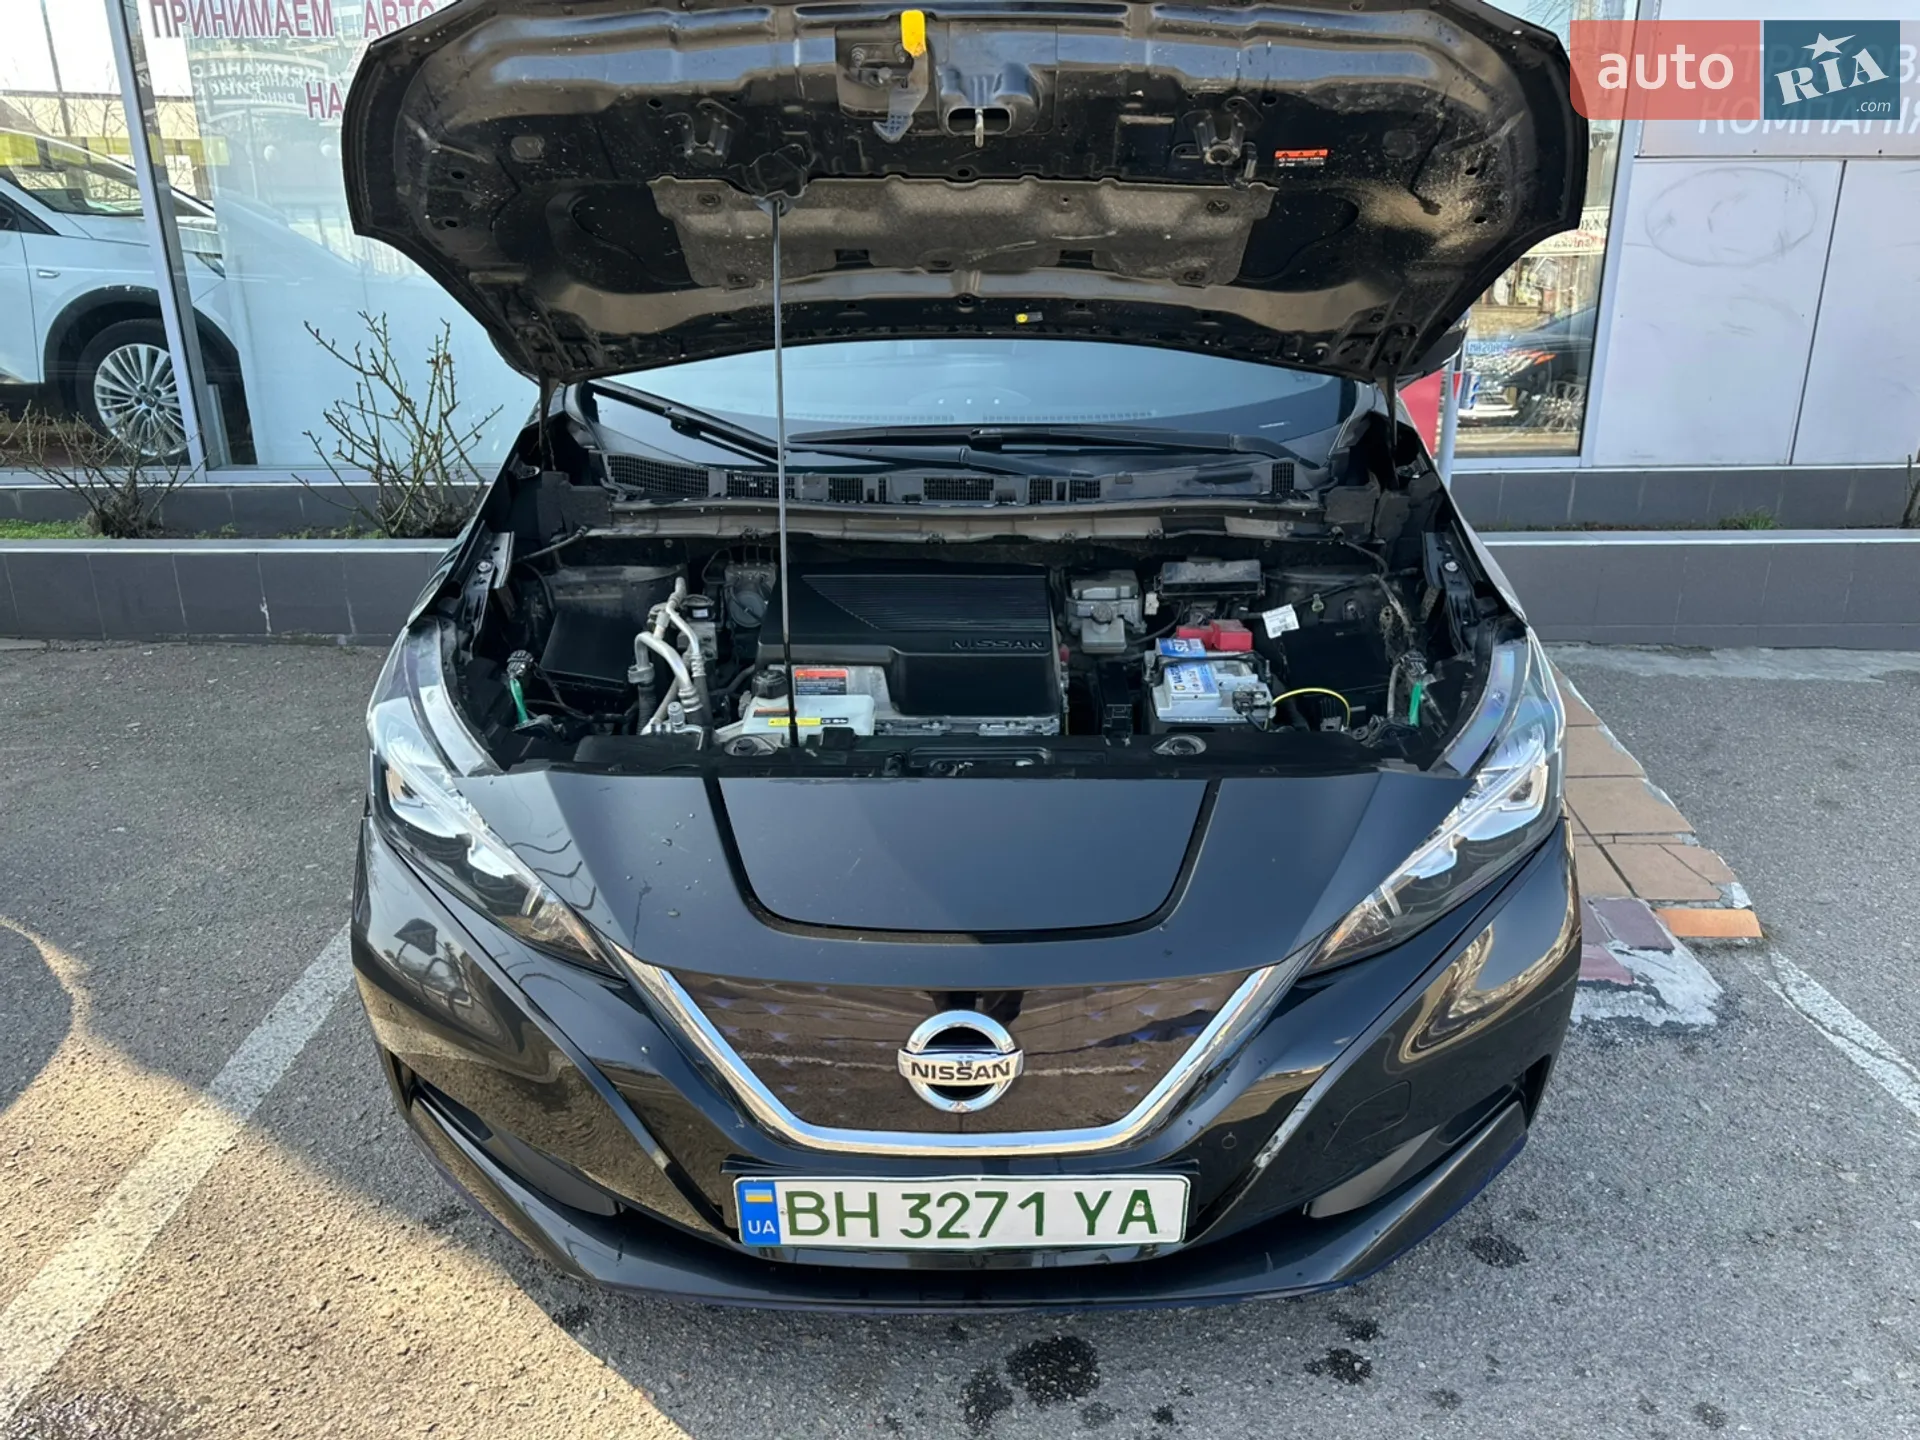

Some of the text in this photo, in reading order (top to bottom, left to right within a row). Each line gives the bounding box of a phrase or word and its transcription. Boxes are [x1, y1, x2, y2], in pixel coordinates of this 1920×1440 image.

[149, 0, 335, 38] ПРИНИМАЕМ
[305, 81, 345, 119] НА
[951, 638, 1045, 650] NISSAN
[911, 1061, 1011, 1081] NISSAN
[747, 1219, 776, 1235] UA
[785, 1189, 1158, 1239] BH 3271 YA
